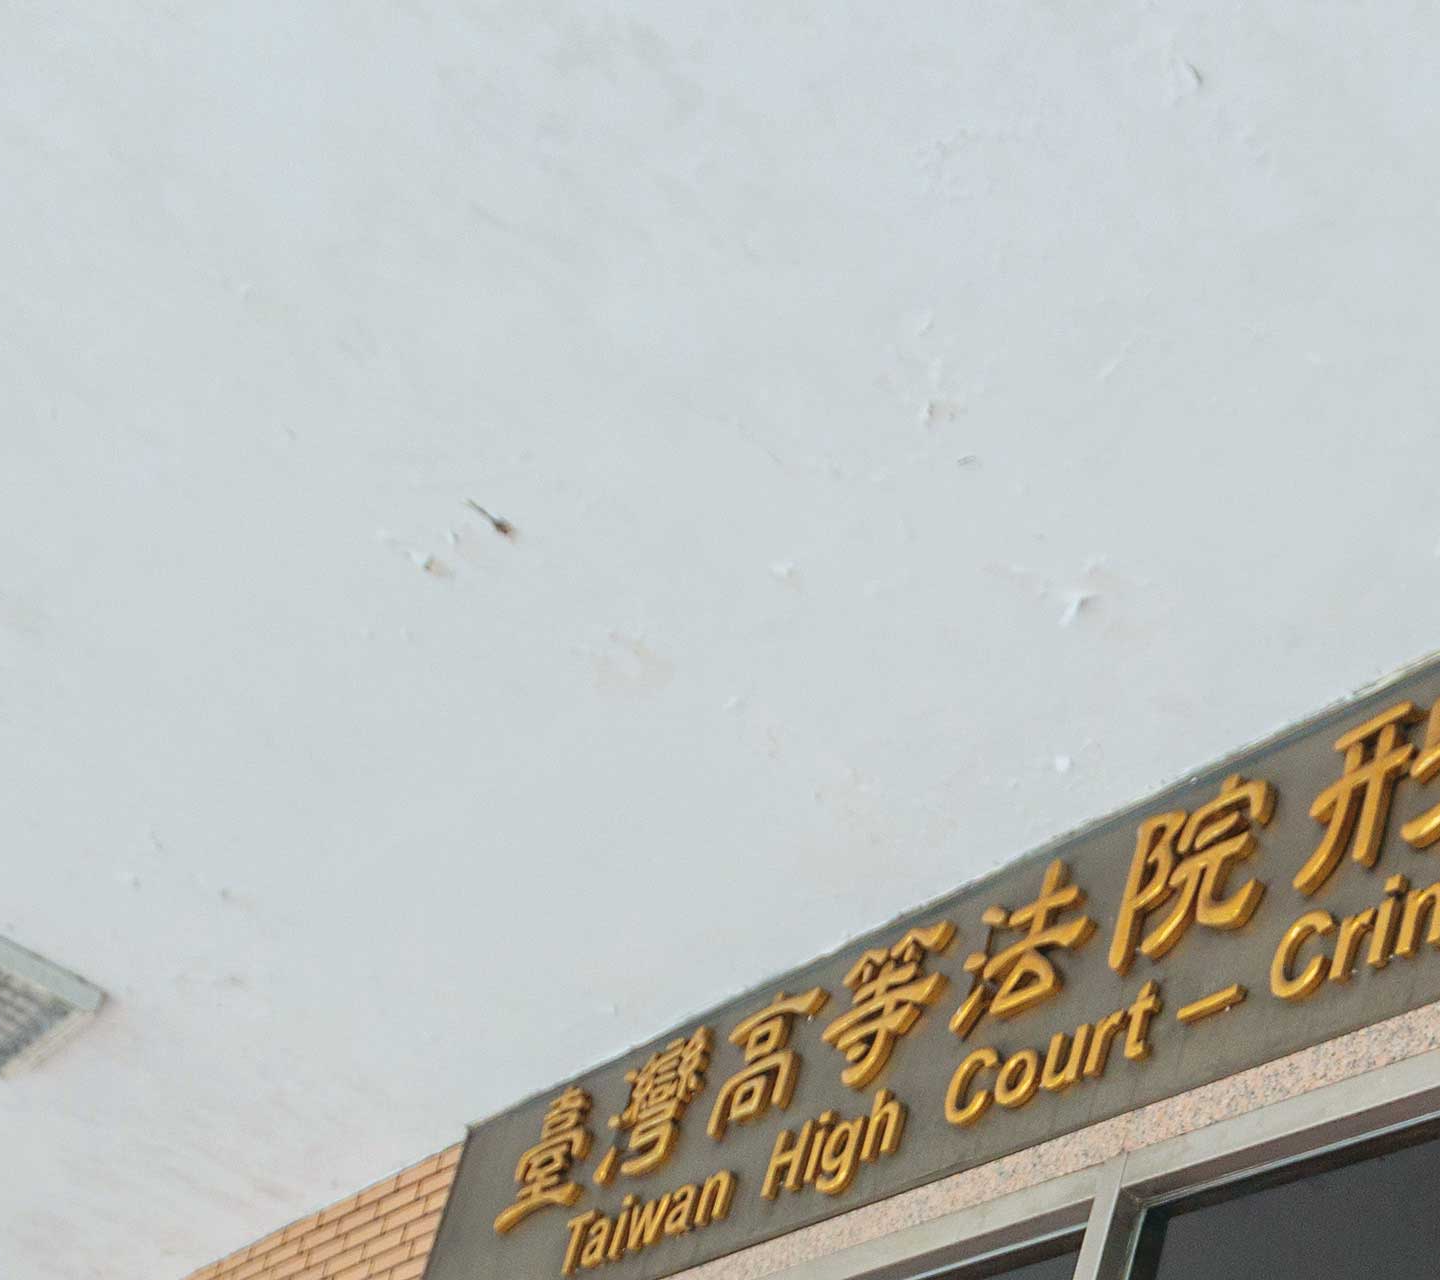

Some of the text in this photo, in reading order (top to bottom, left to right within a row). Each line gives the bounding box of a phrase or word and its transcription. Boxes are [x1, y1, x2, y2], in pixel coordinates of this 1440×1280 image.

[562, 1168, 737, 1277] Taiwan
[761, 1086, 906, 1200] High
[944, 980, 1164, 1126] Court
